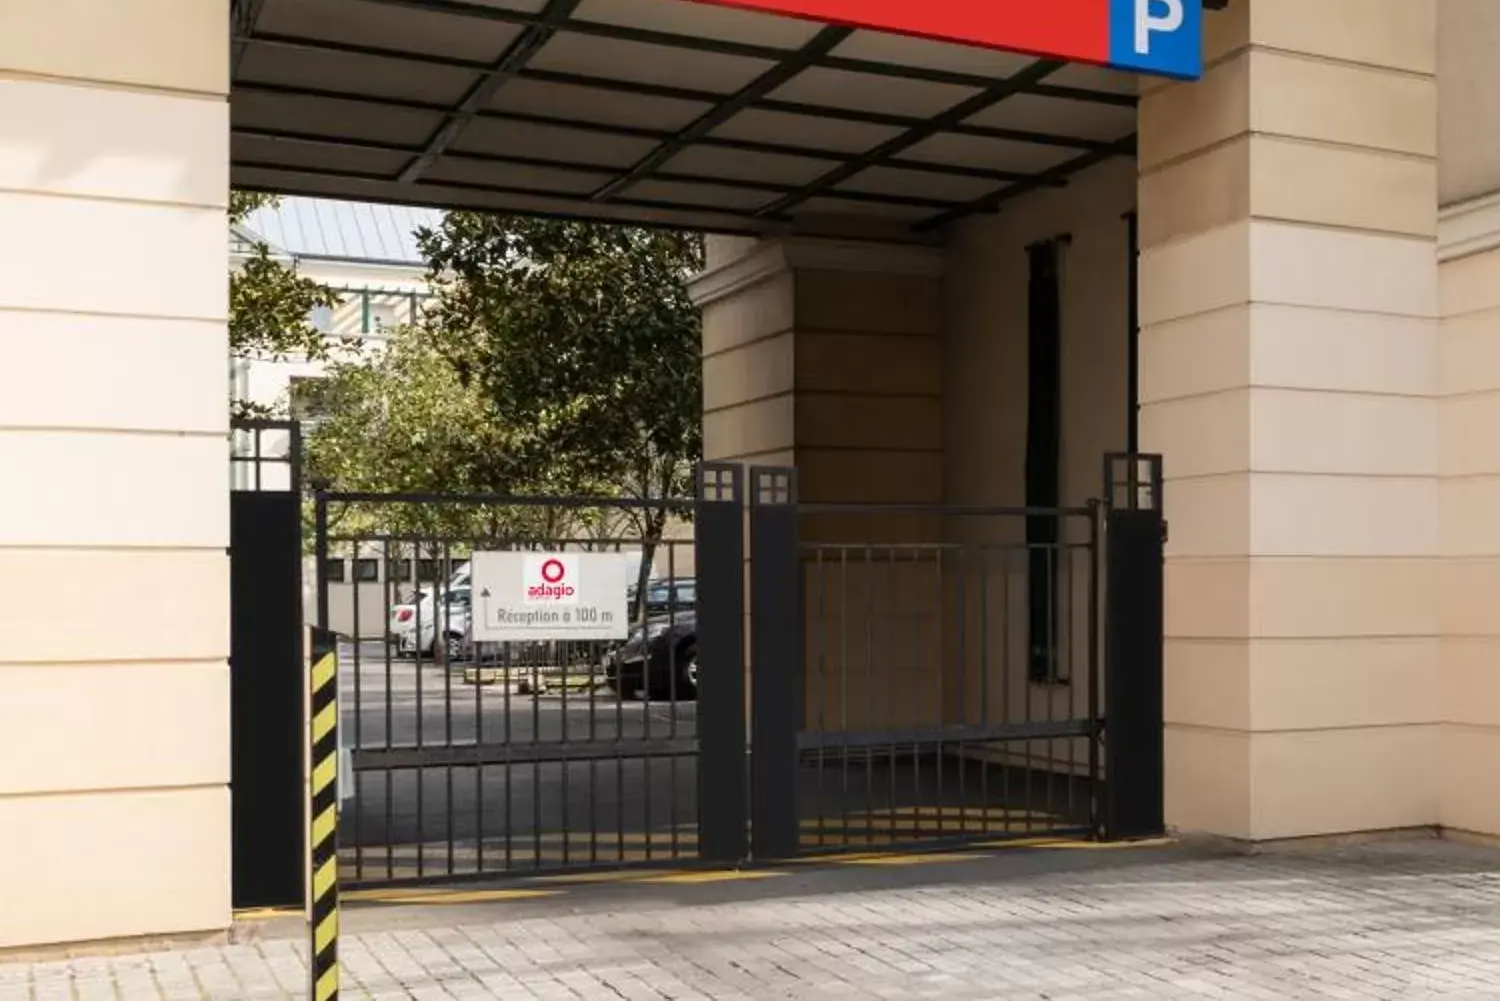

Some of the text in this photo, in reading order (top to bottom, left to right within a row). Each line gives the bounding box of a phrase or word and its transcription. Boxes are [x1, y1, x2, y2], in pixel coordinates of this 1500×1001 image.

[528, 583, 574, 599] adagio
[575, 607, 597, 622] 100
[601, 611, 613, 622] m
